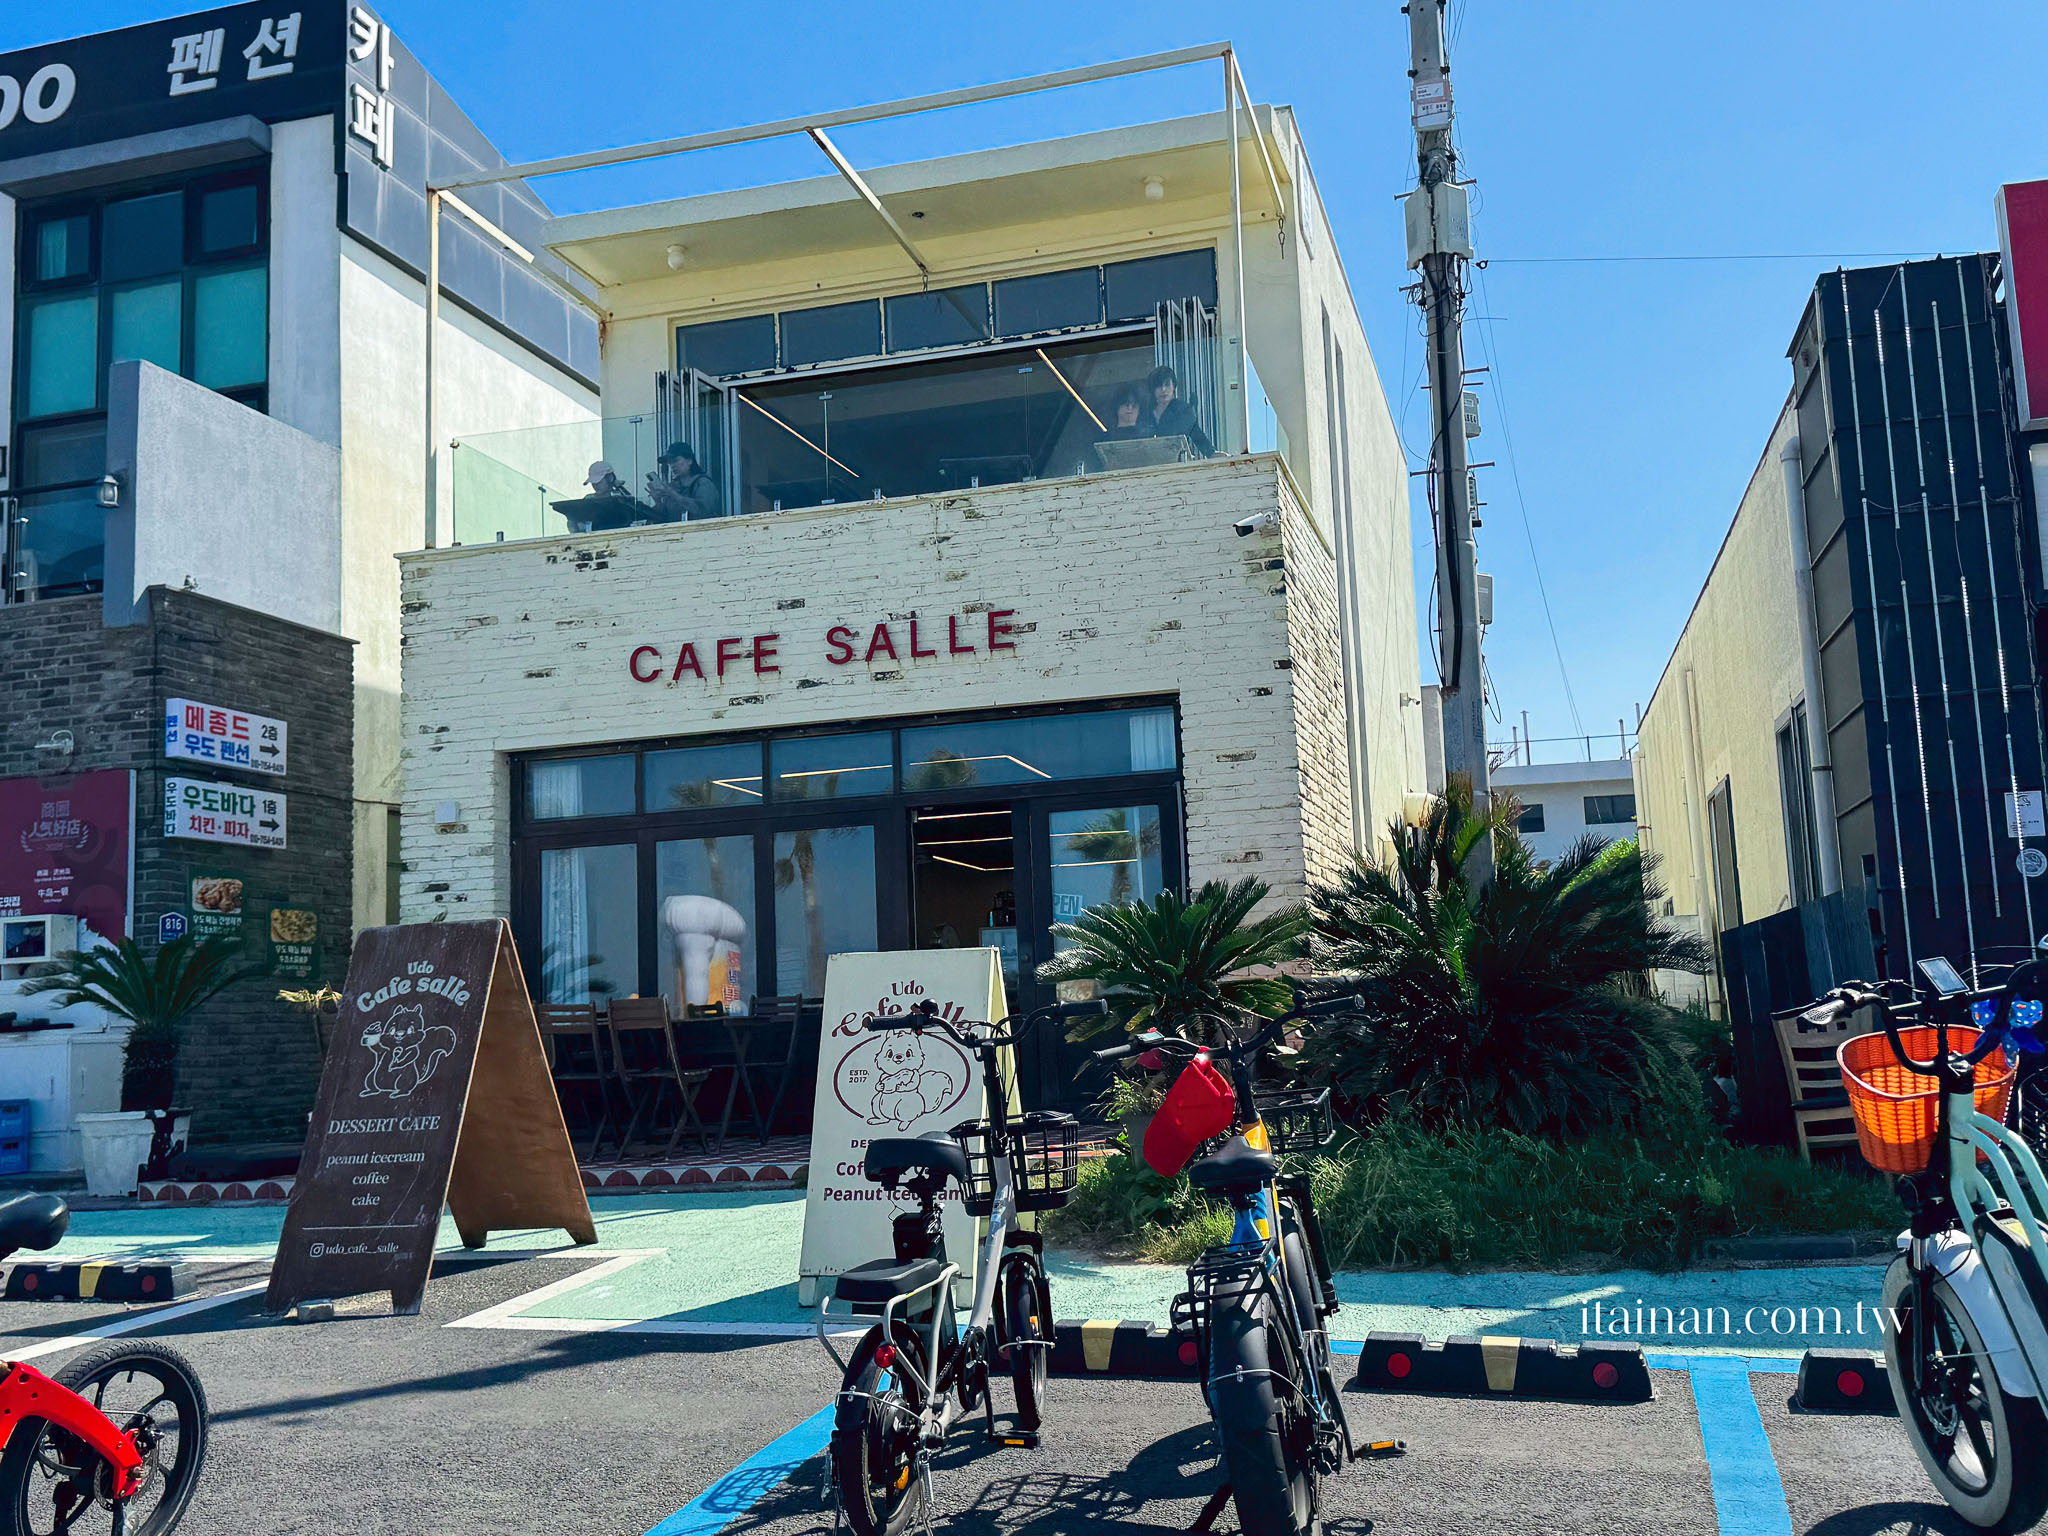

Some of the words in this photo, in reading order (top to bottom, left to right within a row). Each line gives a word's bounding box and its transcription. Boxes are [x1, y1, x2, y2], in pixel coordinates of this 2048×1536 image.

[167, 11, 302, 96] 펜션
[350, 6, 396, 170] 카페
[629, 633, 780, 684] CAFE
[825, 608, 1016, 666] SALLE
[167, 714, 178, 743] 펜션
[185, 705, 250, 741] 메종드
[261, 724, 278, 742] 2층
[185, 733, 216, 758] 우도
[220, 740, 250, 765] 펜션
[165, 781, 177, 834] 우도바다
[183, 785, 256, 817] 우도바다
[263, 799, 277, 815] 1층
[166, 918, 181, 930] 816
[407, 960, 434, 975] Udo
[357, 976, 411, 1013] Cafe
[416, 975, 471, 1006] salle
[892, 980, 924, 996] Udo
[328, 1118, 397, 1134] DESSERT
[399, 1115, 441, 1132] CAFE
[326, 1154, 369, 1168] peanut
[370, 1151, 425, 1163] icecream
[352, 1172, 390, 1184] coffee
[352, 1193, 380, 1206] cake
[824, 1187, 883, 1201] Peanut
